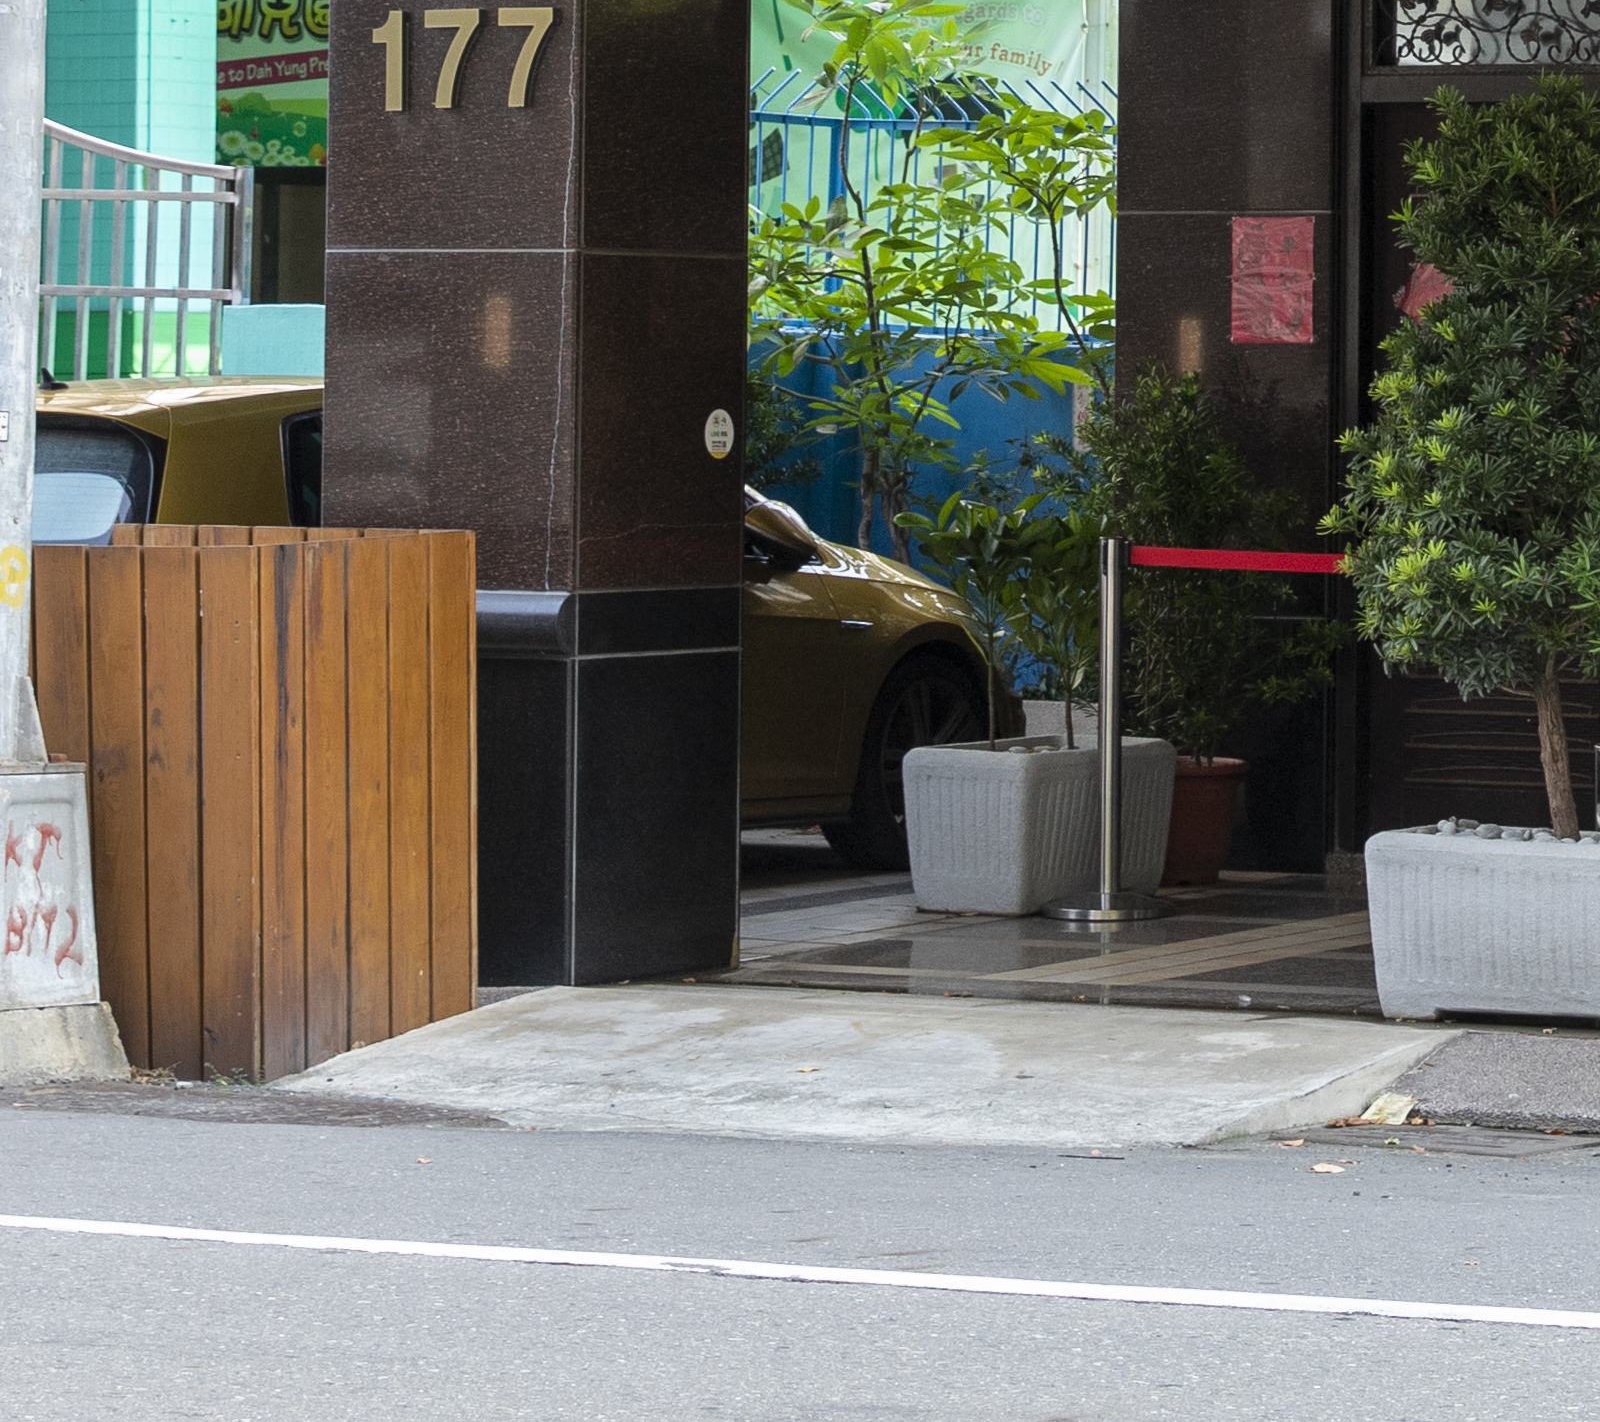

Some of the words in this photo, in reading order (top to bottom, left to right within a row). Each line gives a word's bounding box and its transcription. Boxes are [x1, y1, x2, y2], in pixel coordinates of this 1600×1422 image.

[1024, 4, 1045, 24] to
[228, 68, 244, 81] to
[246, 62, 272, 79] Dah
[275, 59, 307, 78] Yung
[372, 7, 553, 111] 177
